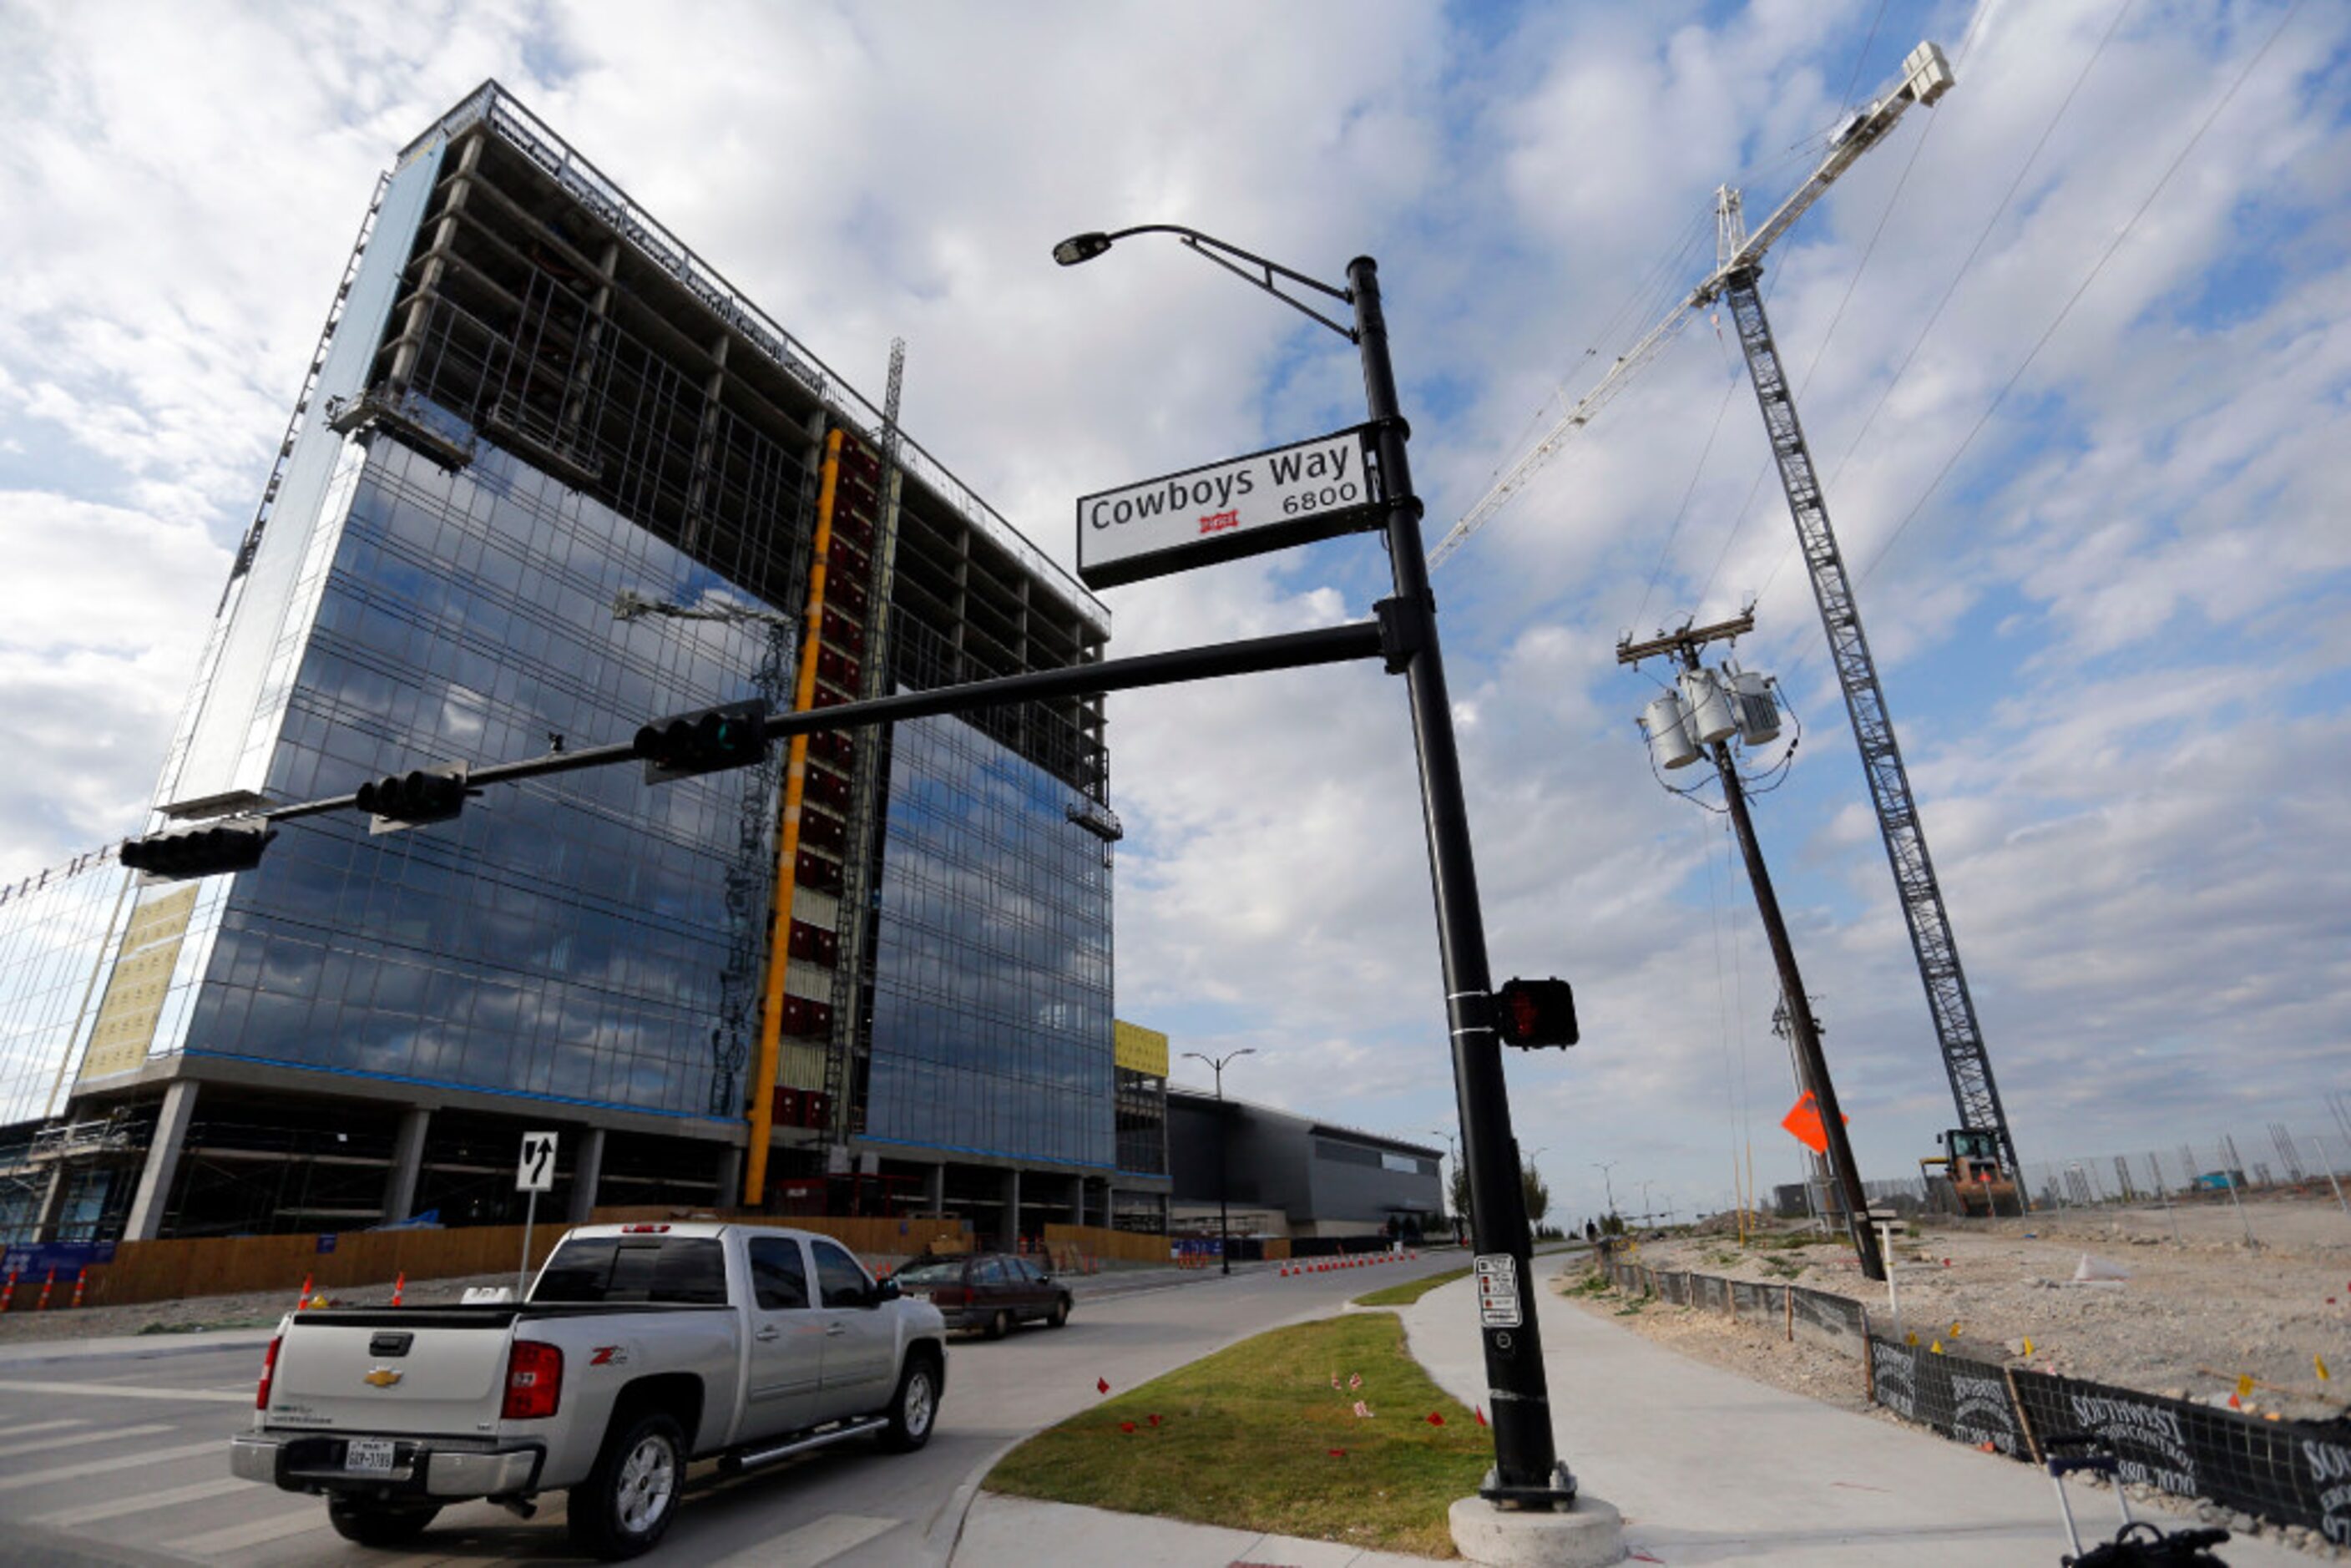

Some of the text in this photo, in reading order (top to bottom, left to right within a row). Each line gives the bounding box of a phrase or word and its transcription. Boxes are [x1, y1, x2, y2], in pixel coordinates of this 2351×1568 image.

[1091, 469, 1254, 530] Cowboys
[1269, 445, 1349, 486] Way
[1282, 482, 1358, 515] 6800
[2071, 1395, 2185, 1446] SOUTHWEST
